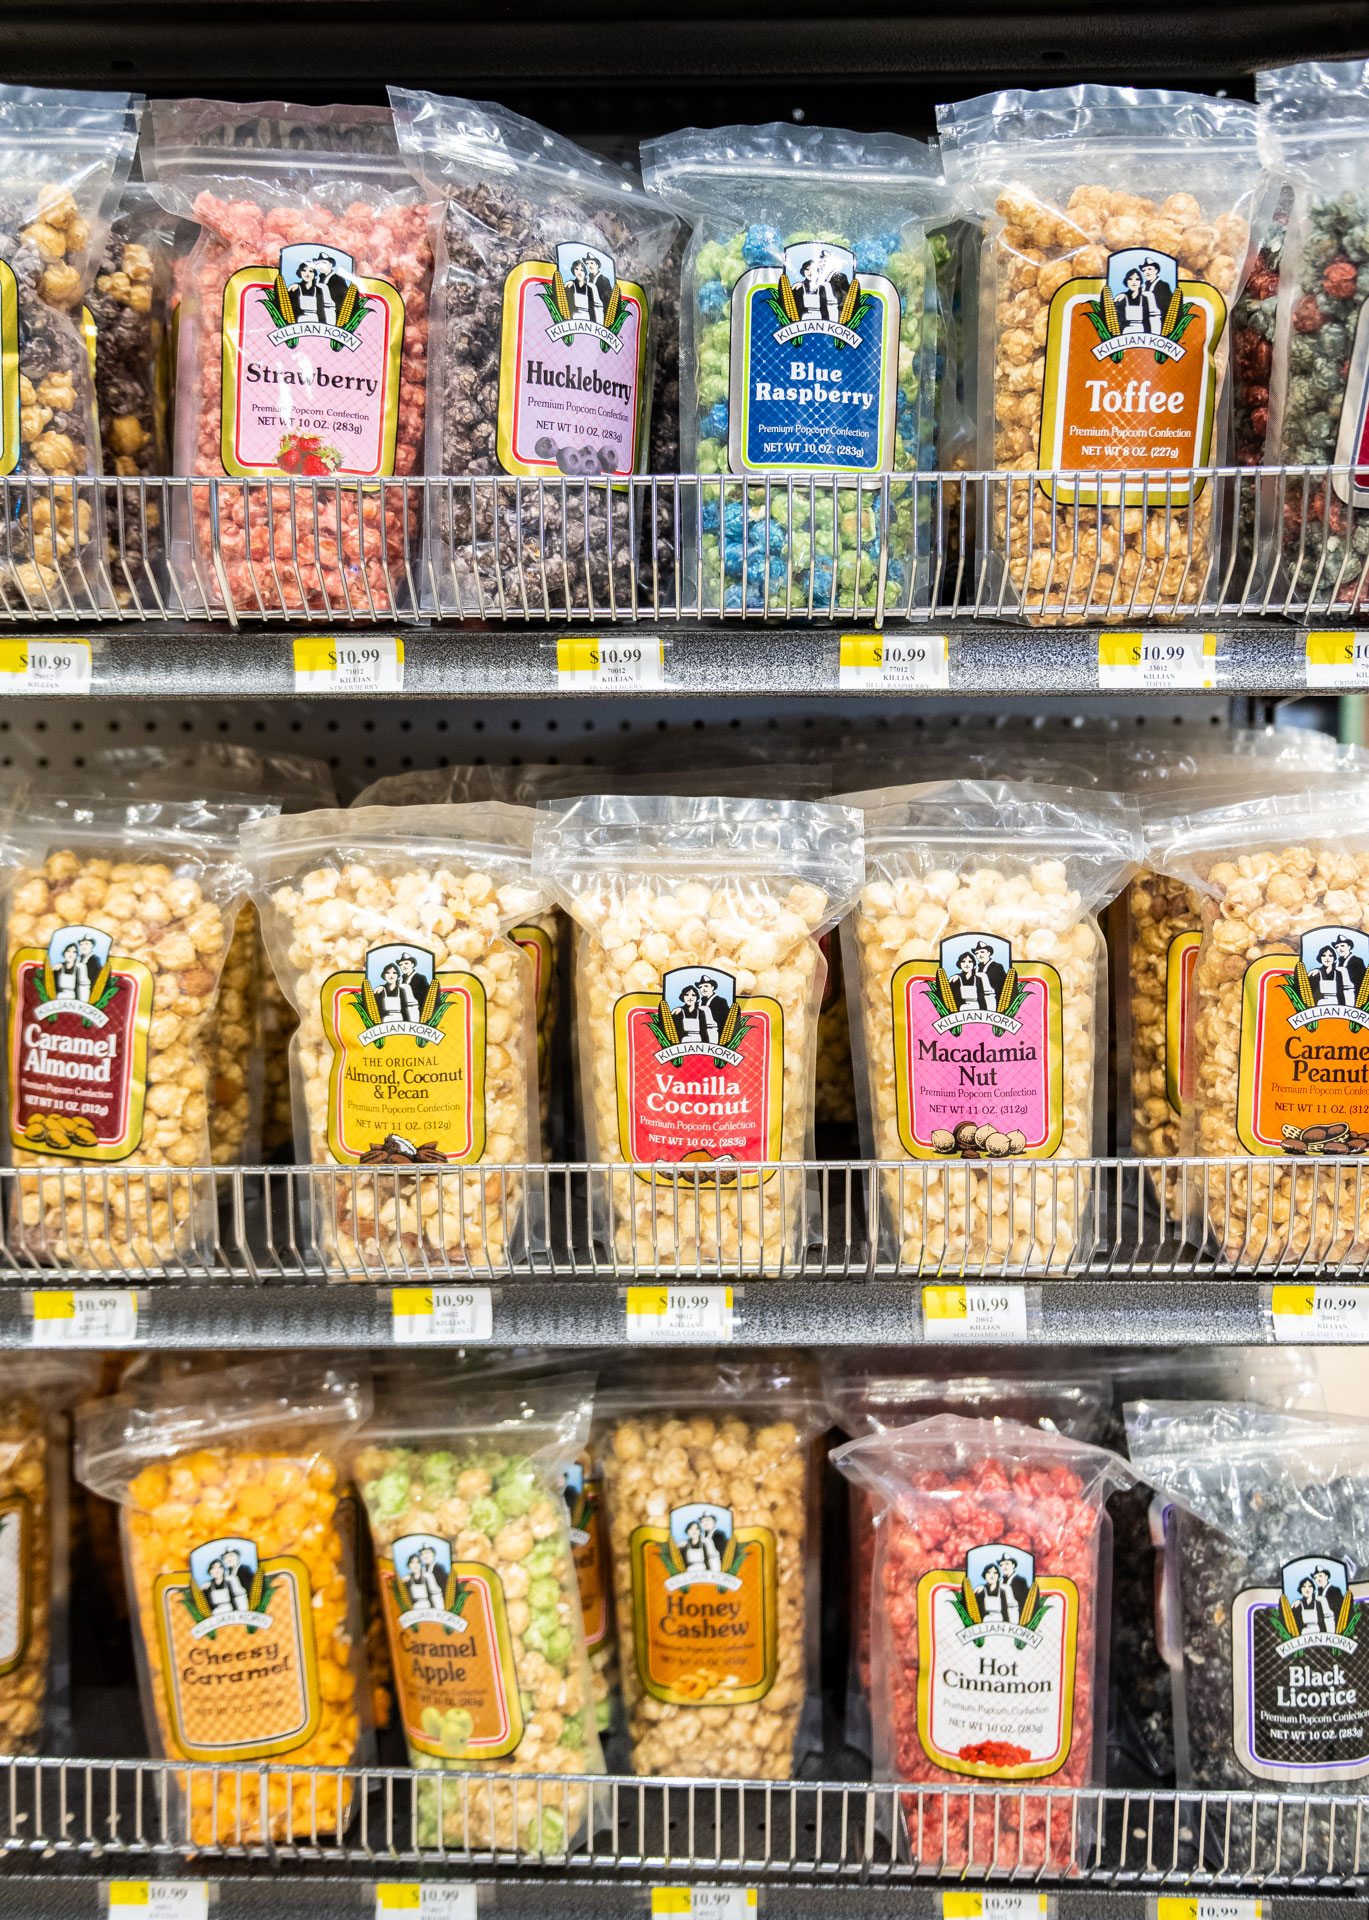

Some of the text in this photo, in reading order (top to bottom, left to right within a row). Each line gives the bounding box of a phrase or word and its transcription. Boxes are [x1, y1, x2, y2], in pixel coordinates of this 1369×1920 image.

[272, 325, 357, 347] KILLIAN KORN
[551, 322, 620, 349] KILLIAN KORN
[777, 323, 859, 344] KILLIAN KORN
[1097, 336, 1181, 357] KILLIAN KORN
[790, 362, 842, 382] Blue
[526, 360, 632, 405] Huckleberry
[756, 382, 873, 409] Raspberry
[1085, 380, 1184, 414] Toffee
[327, 409, 369, 420] Confection
[528, 397, 629, 422] Premium Popcorn Confection
[257, 417, 362, 434] NET 10 OZ. (283g)
[536, 420, 622, 442] NET WT 10 OZ. (283g)
[759, 424, 869, 438] Premium Popcorn Confection
[1069, 425, 1191, 438] Premium Popcorn Confection
[763, 443, 864, 457] NET WT 10 OZ. (283g)
[1081, 446, 1178, 458] NET WT 8 OZ. (227g)
[19, 654, 71, 670] $10.99
[328, 649, 379, 665] $10.99
[590, 649, 641, 664] $10.99
[873, 648, 925, 662] $10.99
[1132, 647, 1184, 661] $10.99
[39, 1001, 105, 1025] KILLIAN KORN
[938, 1013, 1018, 1031] KILLIAN KORN
[1293, 1008, 1340, 1026] KILLIAN
[25, 1024, 117, 1057] Caramel
[362, 1024, 441, 1042] KILLIAN KORN
[659, 1045, 740, 1063] KILLIAN KORN
[918, 1039, 1037, 1063] Macadamia
[1285, 1036, 1369, 1060] Carame
[25, 1049, 111, 1082] Almond
[363, 1057, 439, 1067] THE ORIGINAL
[345, 1067, 463, 1086] Almond, Coconut
[959, 1066, 997, 1086] Nut
[1292, 1060, 1369, 1083] Peanut
[374, 1086, 429, 1099] & Pecan
[656, 1073, 740, 1096] Vanilla
[920, 1086, 1037, 1100] Premium Popcorn Confection
[1272, 1083, 1342, 1096] Premium Popcorn
[66, 1100, 80, 1111] OZ.
[348, 1100, 460, 1115] Premium Popcorn Confection
[647, 1093, 749, 1115] Coconut
[929, 1105, 1028, 1115] NET WT 11 OZ. (312g)
[1275, 1102, 1346, 1113] NET WT 11 OZ.
[356, 1119, 451, 1130] NET WT 11 OZ. (312g)
[640, 1115, 756, 1132] Premium Popcorn Confection
[649, 1134, 666, 1143] NET
[669, 1137, 684, 1145] WT
[701, 1138, 716, 1147] OZ.
[719, 1137, 746, 1148] (283g)
[67, 1299, 117, 1312] $10.99
[425, 1295, 474, 1308] $10.99
[659, 1295, 709, 1309] $10.99
[959, 1298, 1009, 1312] $10.99
[1305, 1297, 1356, 1310] $10.99
[666, 1595, 741, 1620] Honey
[660, 1616, 749, 1638] Cashew
[962, 1625, 1038, 1644] KILLIAN KORN
[400, 1631, 477, 1657] Caramel
[1280, 1636, 1354, 1654] KILLIAN KORN
[189, 1642, 279, 1665] Cheesy
[183, 1654, 291, 1686] Caramel
[413, 1658, 466, 1686] Apple
[979, 1658, 1019, 1676] Hot
[1289, 1664, 1346, 1686] Black
[943, 1669, 1052, 1694] Cinnamon
[1277, 1686, 1357, 1707] Licorice
[949, 1718, 966, 1729] NET
[969, 1722, 982, 1730] WT
[987, 1723, 997, 1733] 10
[1001, 1725, 1015, 1733] OZ.
[1261, 1711, 1298, 1723] Premium
[1299, 1714, 1332, 1725] Popcorn
[1270, 1727, 1363, 1740] NET WT 10 OZ. (283g)
[140, 1887, 188, 1900] $10.99
[411, 1889, 459, 1902] $10.99
[682, 1893, 730, 1906] $10.99
[974, 1898, 1022, 1910] $10.99
[1189, 1906, 1238, 1917] $10.99
